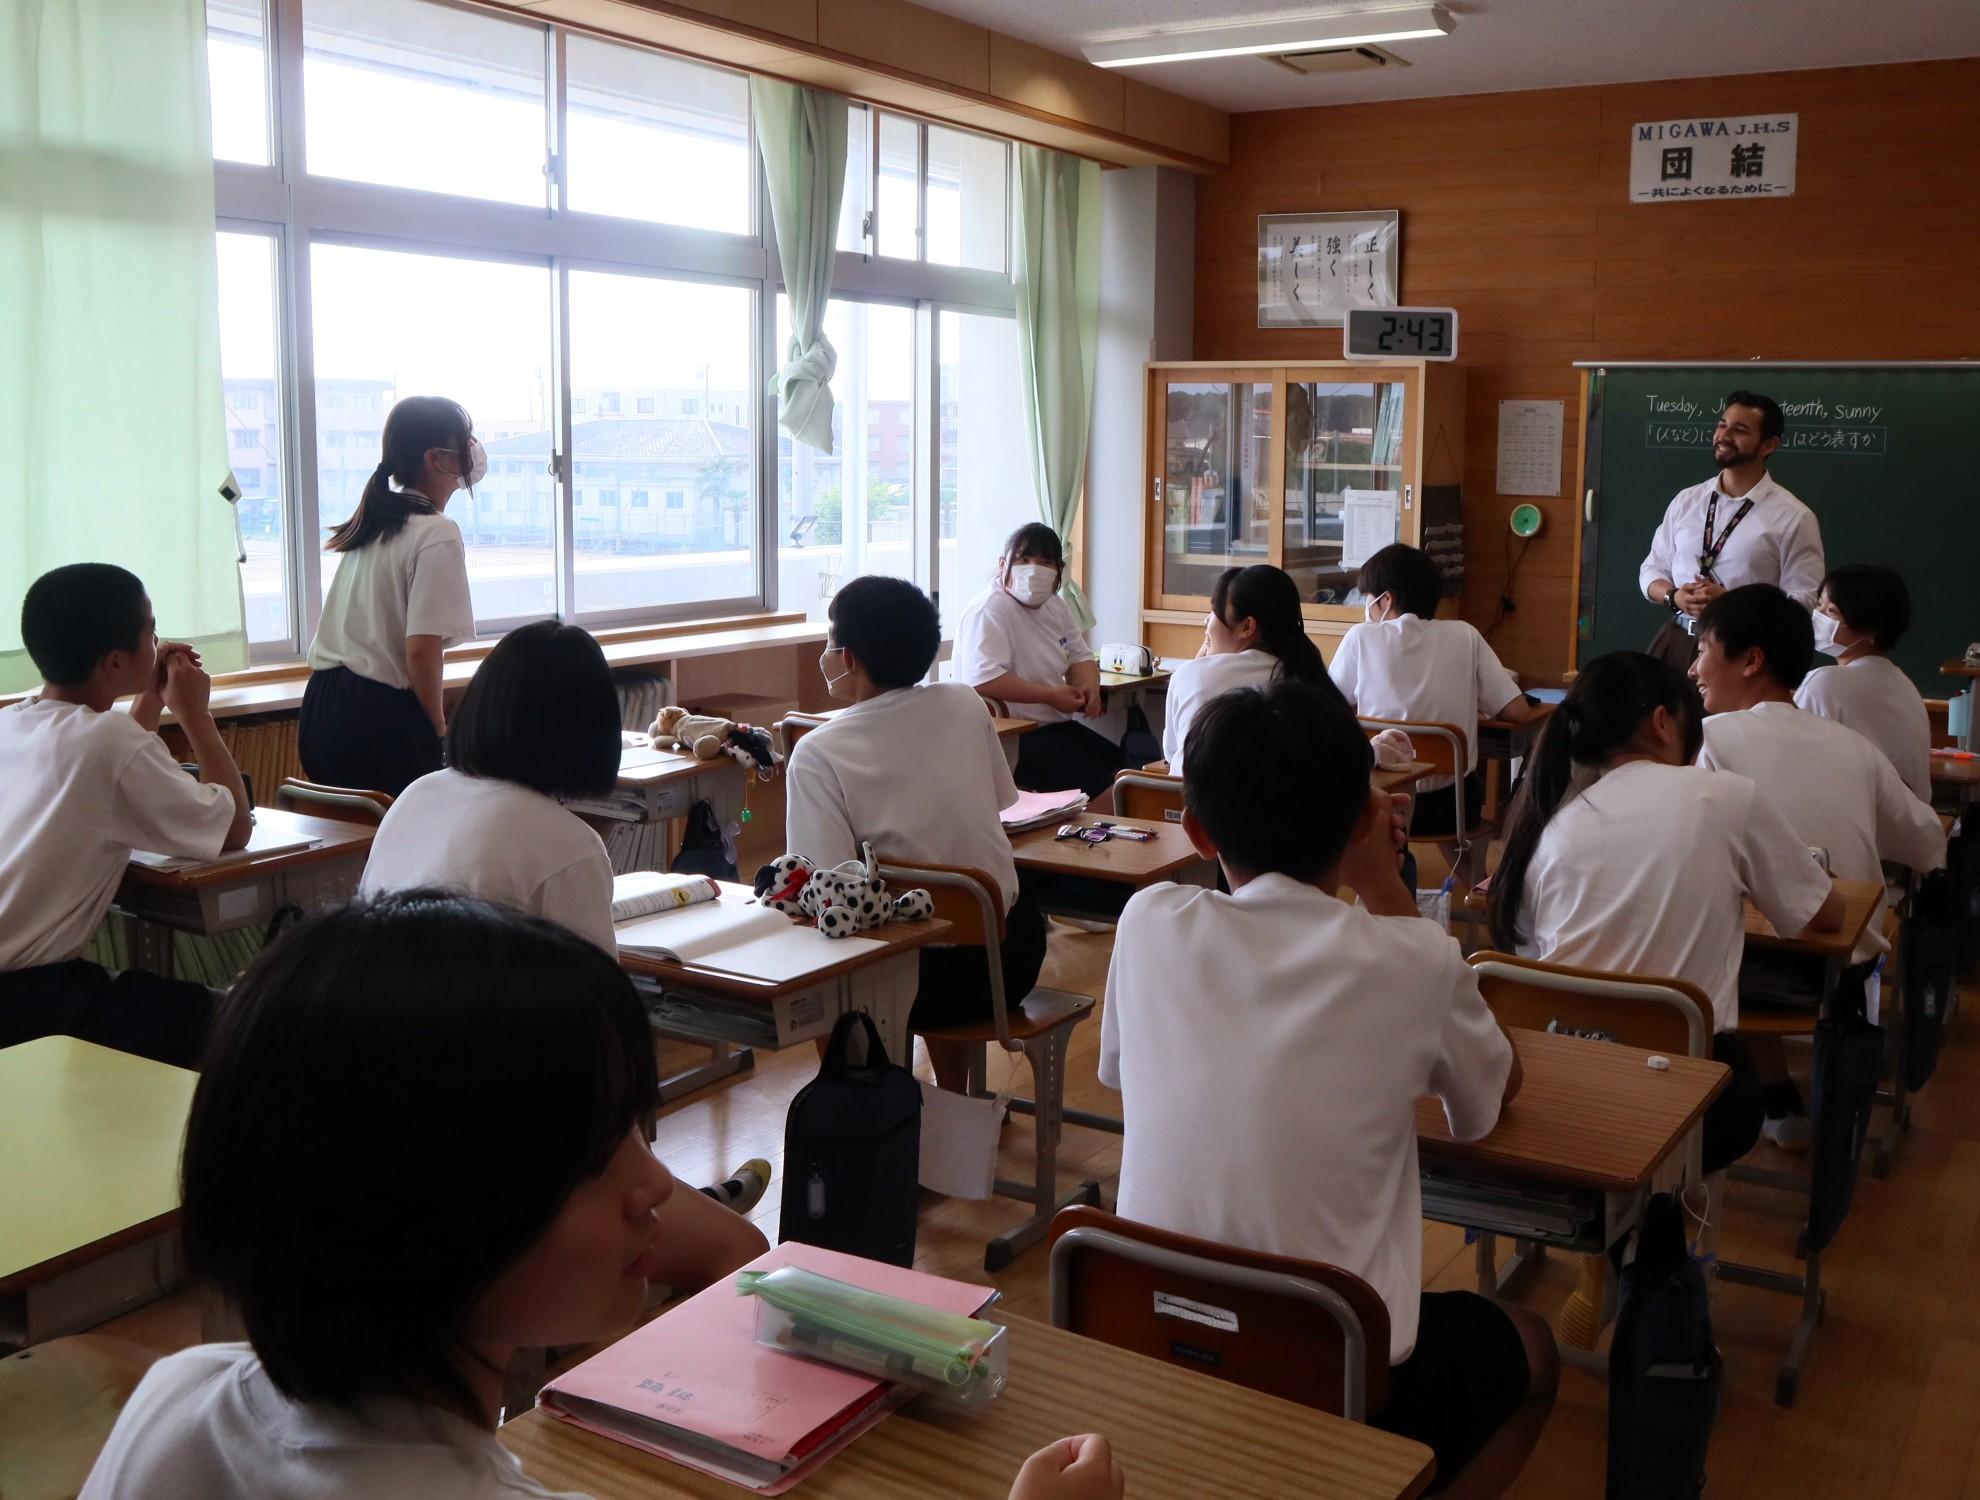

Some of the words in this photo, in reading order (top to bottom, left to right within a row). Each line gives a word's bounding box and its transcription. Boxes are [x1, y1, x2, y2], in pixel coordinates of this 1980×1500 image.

[1639, 122, 1730, 141] MIGAWA
[1289, 236, 1304, 302] 美しく
[1326, 236, 1341, 277] 強く
[1364, 236, 1380, 300] 正しく
[1378, 317, 1444, 351] 2:43
[1646, 394, 1703, 420] Tuesday,
[1778, 396, 1828, 419] teenth,
